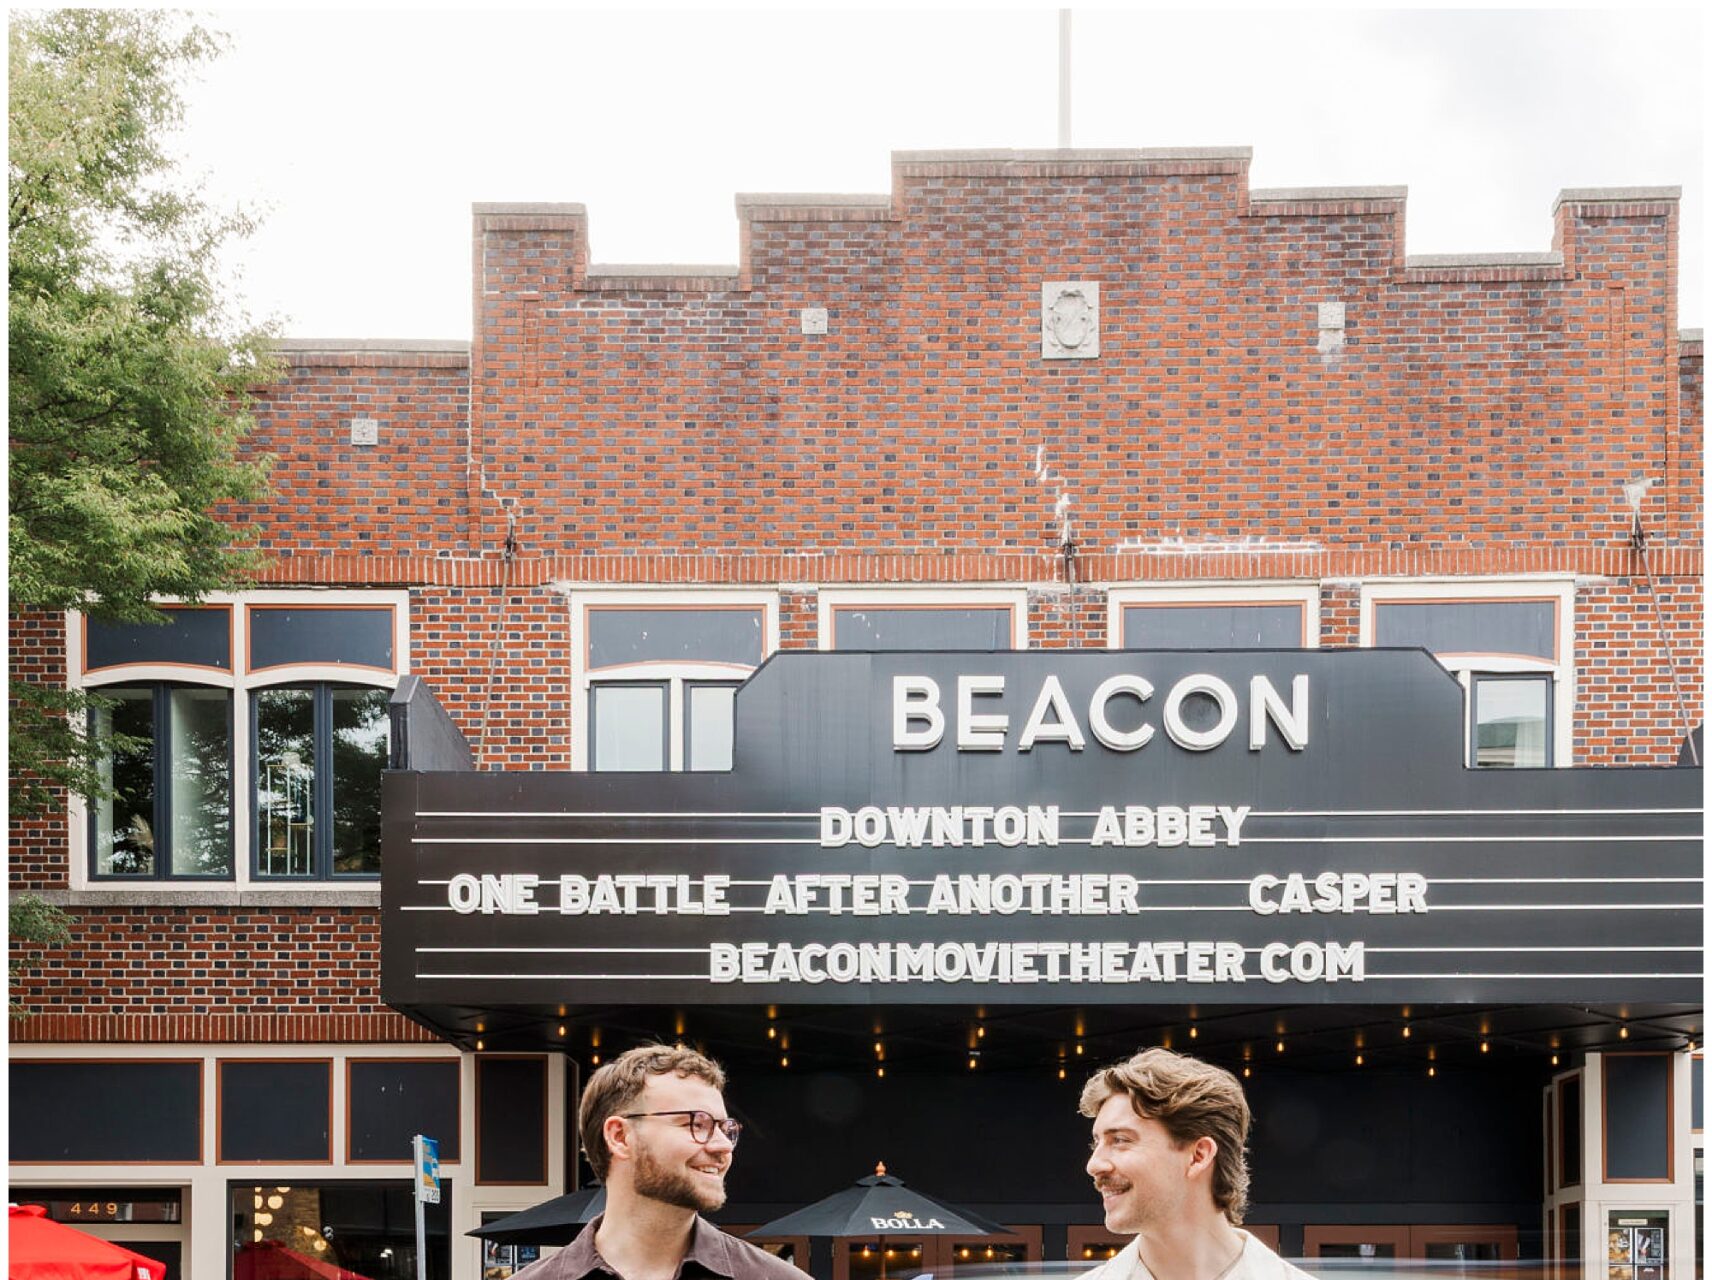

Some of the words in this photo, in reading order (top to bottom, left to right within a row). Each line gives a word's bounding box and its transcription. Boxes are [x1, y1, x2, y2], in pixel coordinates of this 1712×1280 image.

[893, 674, 1310, 752] BEACON
[820, 805, 1060, 848] DOWNTON
[1090, 805, 1251, 847] ABBEY
[447, 872, 539, 915] ONE
[560, 873, 730, 916] BATTLE
[764, 873, 910, 917] AFTER
[926, 873, 1139, 916] ANOTHER
[1249, 872, 1429, 916] CASPER
[70, 1202, 118, 1215] 449
[870, 1217, 945, 1230] BOLLA
